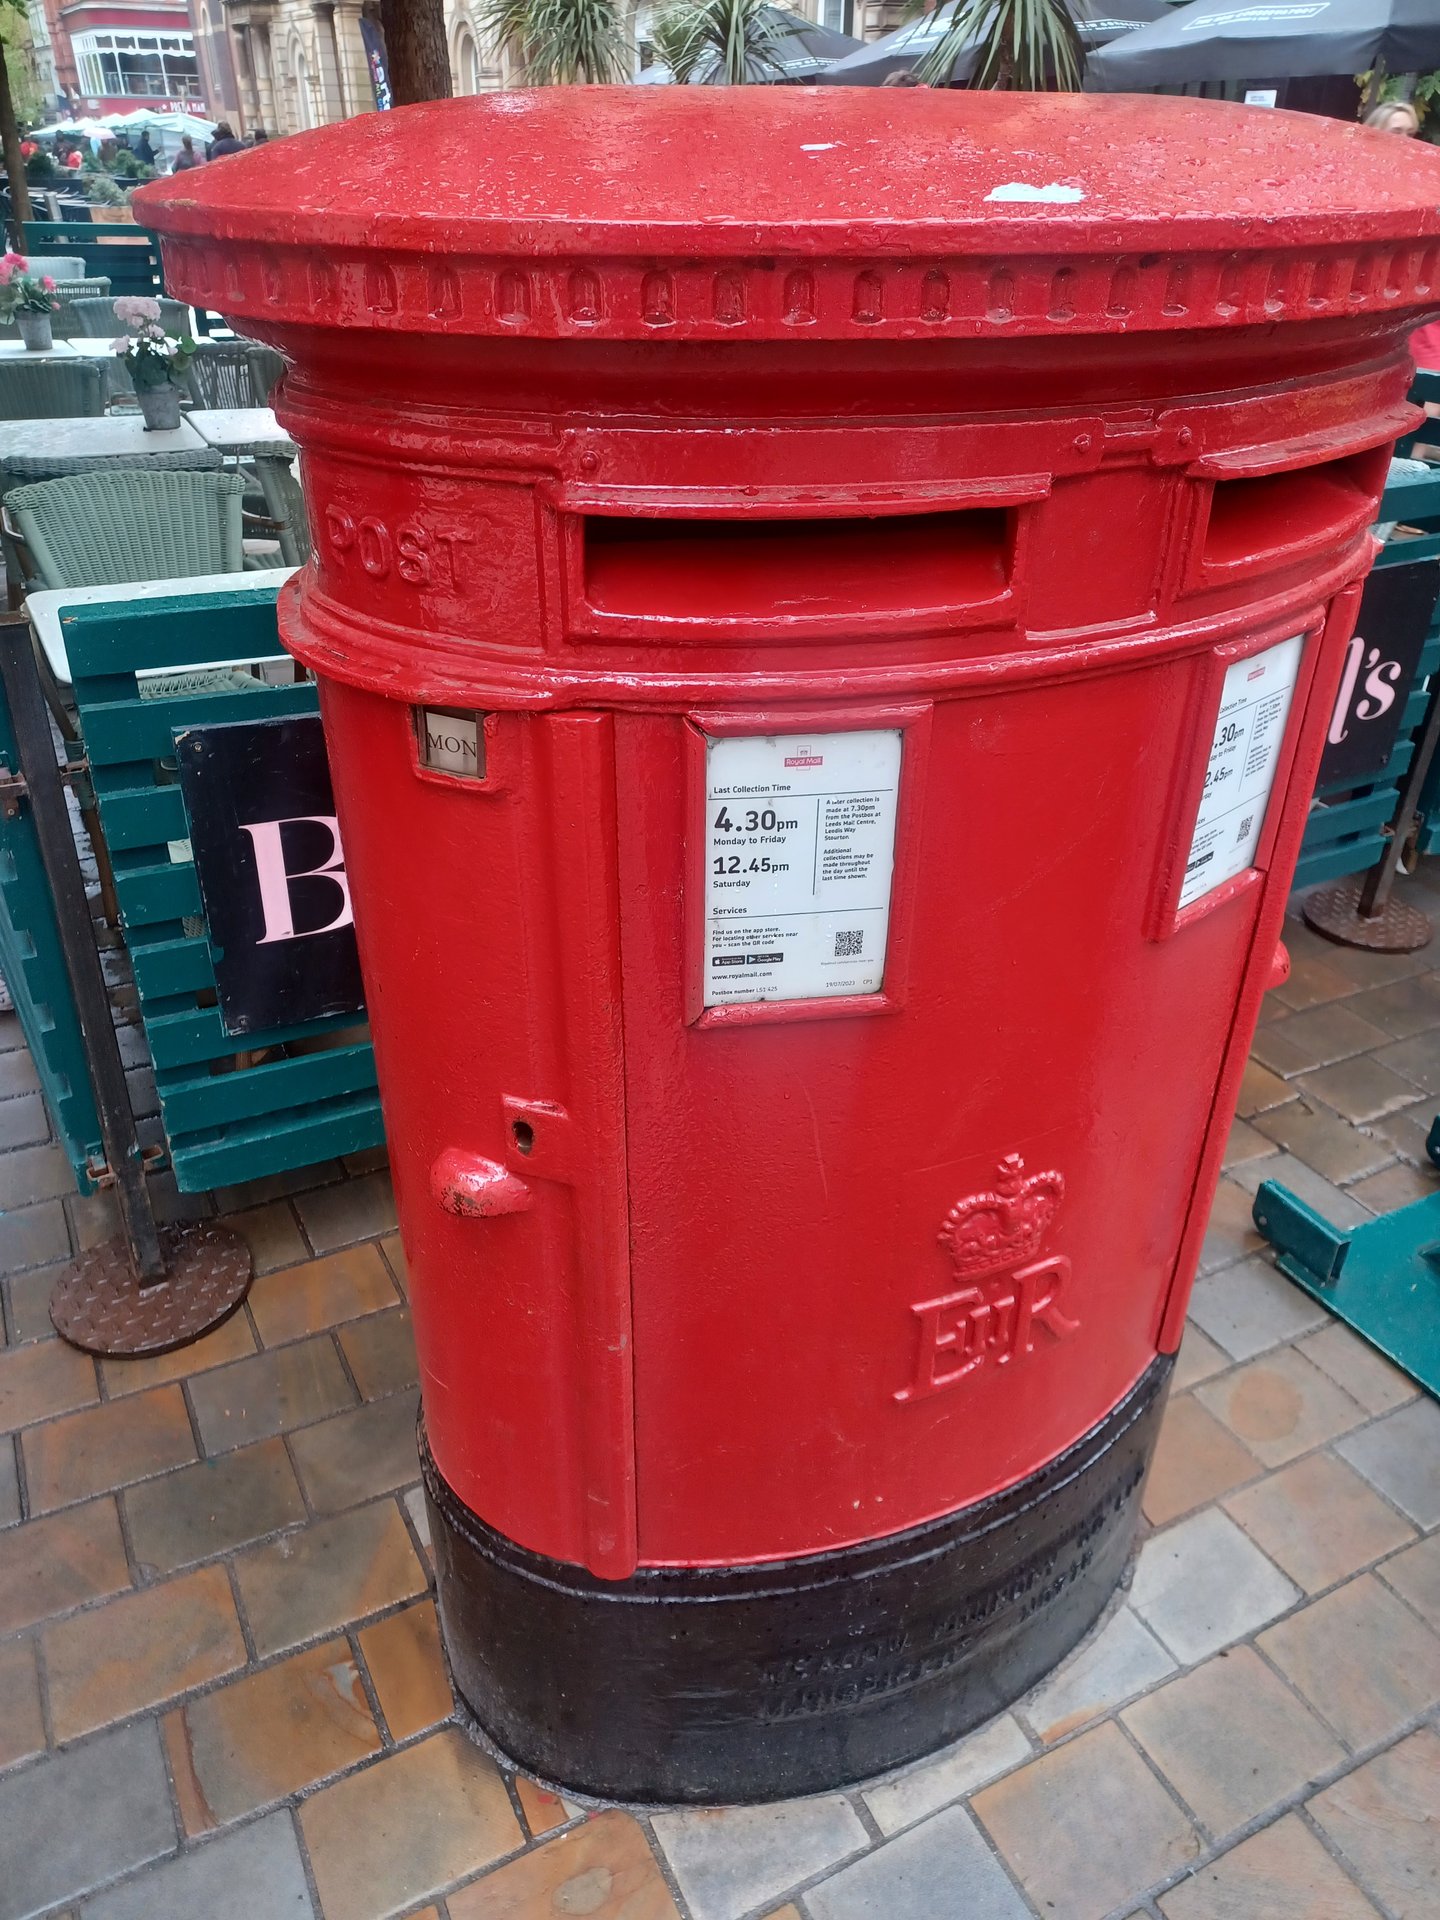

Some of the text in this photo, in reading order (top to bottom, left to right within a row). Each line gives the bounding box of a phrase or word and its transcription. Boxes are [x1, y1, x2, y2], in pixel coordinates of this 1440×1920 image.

[325, 503, 475, 595] POST
[1213, 723, 1244, 749] .30pm
[427, 732, 477, 758] MON
[786, 756, 822, 767] Royal Mail
[1203, 766, 1233, 789] 2.45pm
[733, 784, 770, 793] Collection
[772, 783, 791, 791] Time
[714, 806, 798, 832] 4.30pm
[713, 838, 746, 846] Monday
[760, 835, 787, 843] Friday
[713, 856, 789, 874] 12.45pm
[713, 880, 751, 888] Saturday
[712, 907, 748, 915] Services
[711, 971, 772, 980] www.royalmail.com
